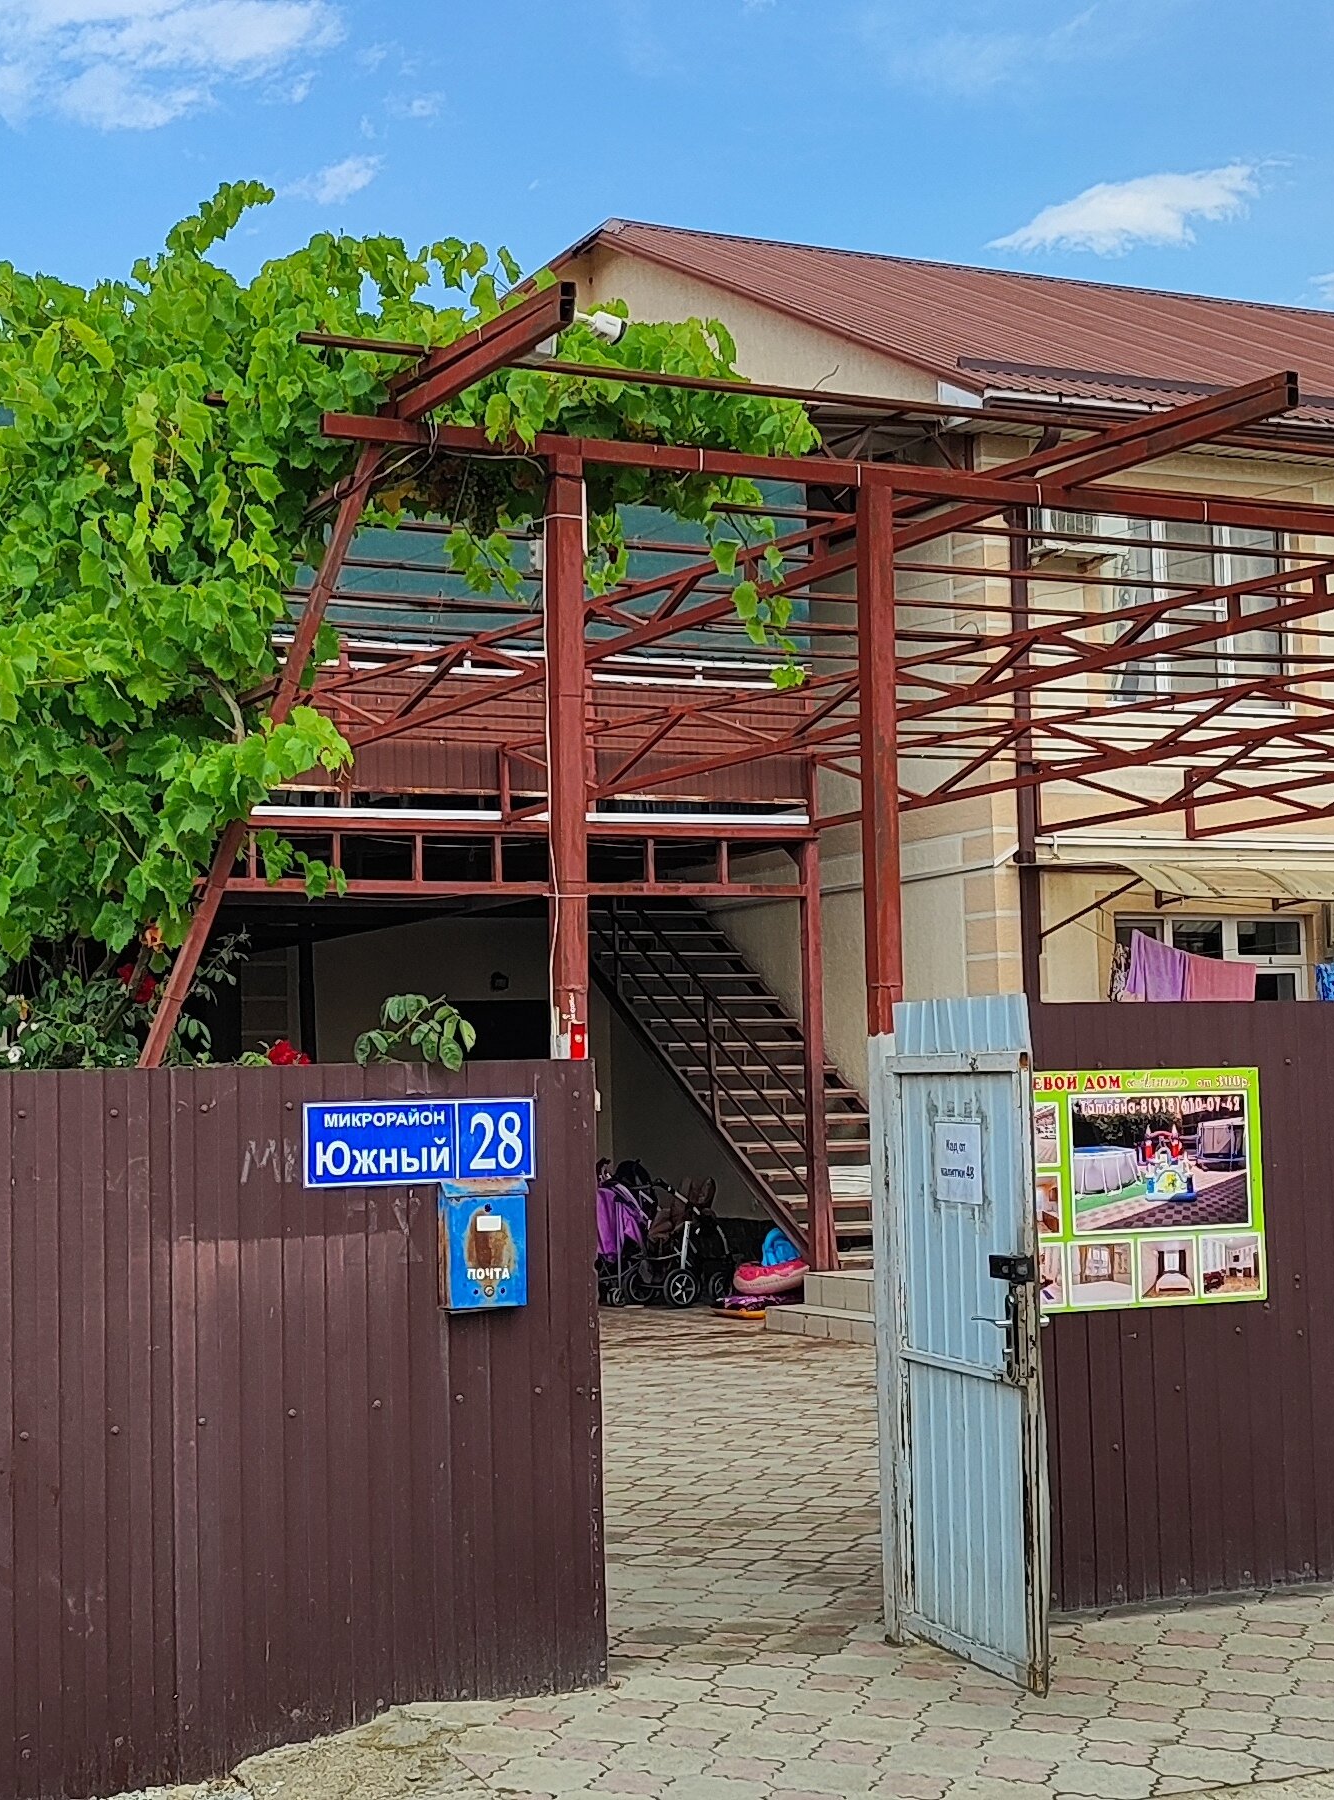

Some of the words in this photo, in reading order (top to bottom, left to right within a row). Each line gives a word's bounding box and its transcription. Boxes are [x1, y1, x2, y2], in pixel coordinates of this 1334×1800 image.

[1084, 1075, 1121, 1091] ДОМ
[323, 1108, 446, 1128] МИКРОРАЙОН
[469, 1111, 523, 1170] 28
[315, 1136, 450, 1176] Южный
